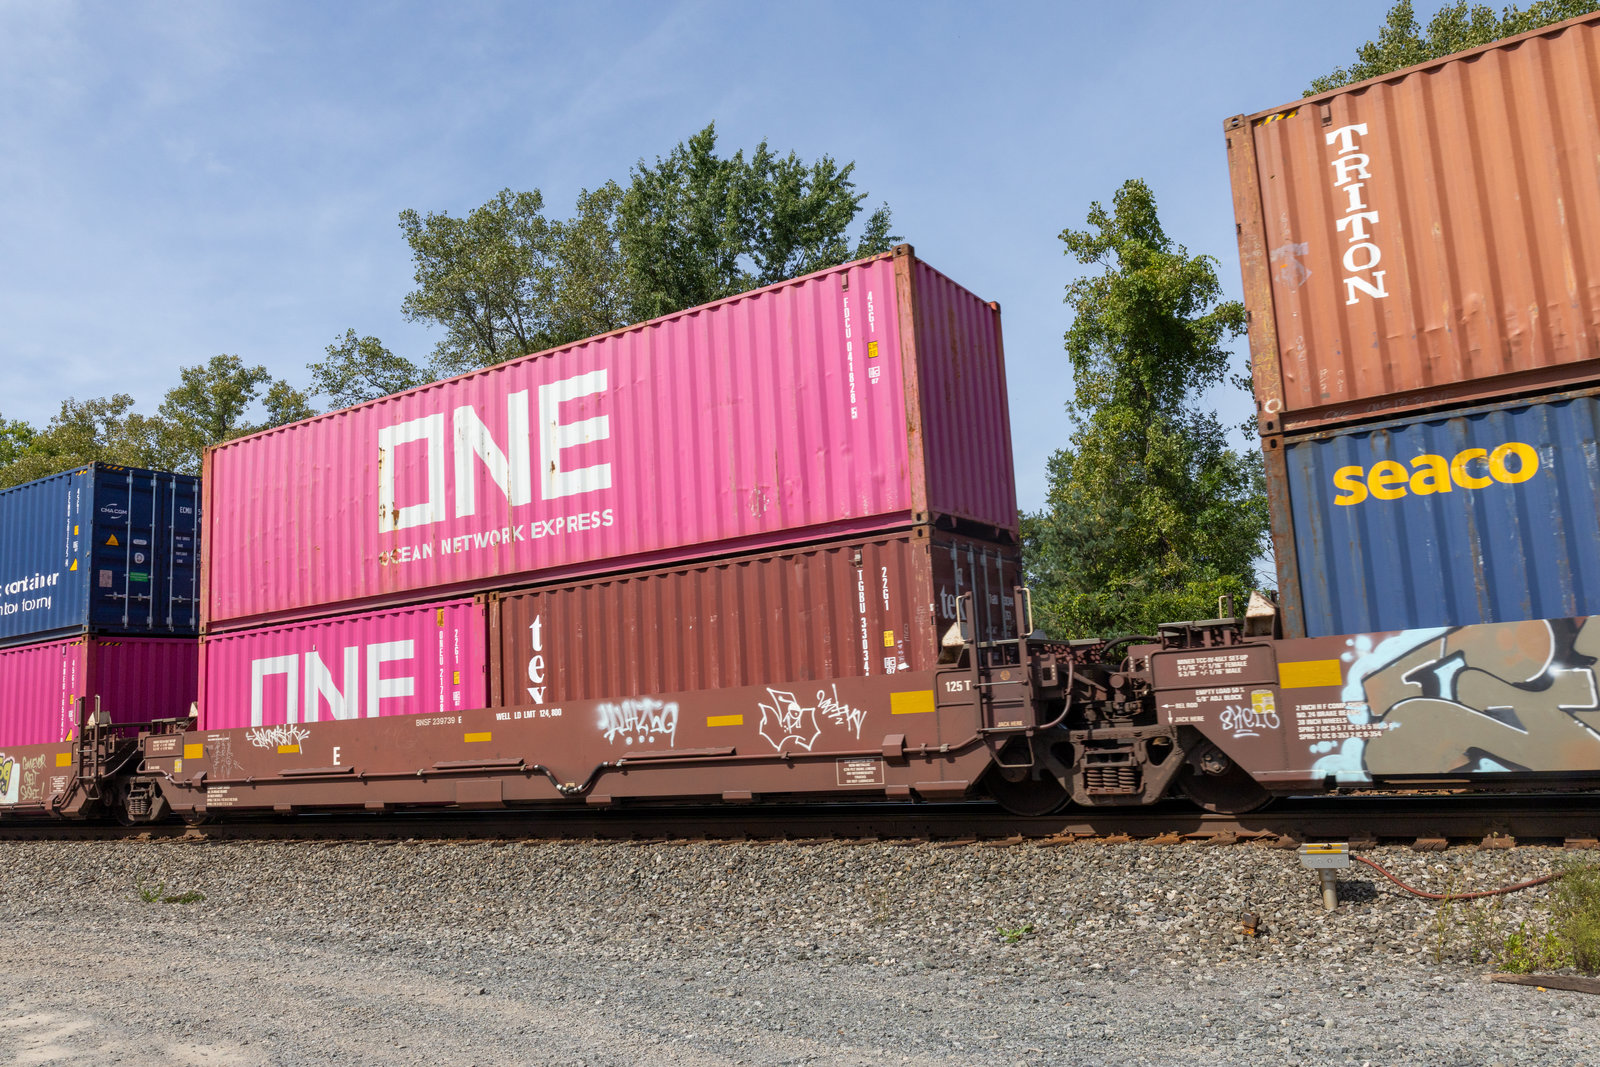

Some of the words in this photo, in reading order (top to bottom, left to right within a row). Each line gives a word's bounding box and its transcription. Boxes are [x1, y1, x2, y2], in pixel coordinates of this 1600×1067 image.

[1325, 122, 1389, 305] TRITON
[851, 406, 858, 420] 5
[378, 367, 613, 534] ONE
[1333, 441, 1540, 507] seaco
[378, 541, 433, 566] OCEAN
[441, 524, 524, 555] NETWORK
[530, 508, 614, 539] EXPRESS
[857, 569, 866, 614] TGBU
[881, 566, 889, 611] 22G1
[945, 681, 963, 693] 125
[964, 680, 972, 691] T
[415, 718, 432, 727] BNSF
[432, 716, 456, 726] 239739
[496, 713, 511, 721] WELL
[514, 711, 522, 719] LD
[523, 710, 537, 719] LMT
[539, 708, 562, 718] 124,800
[332, 746, 341, 766] E
